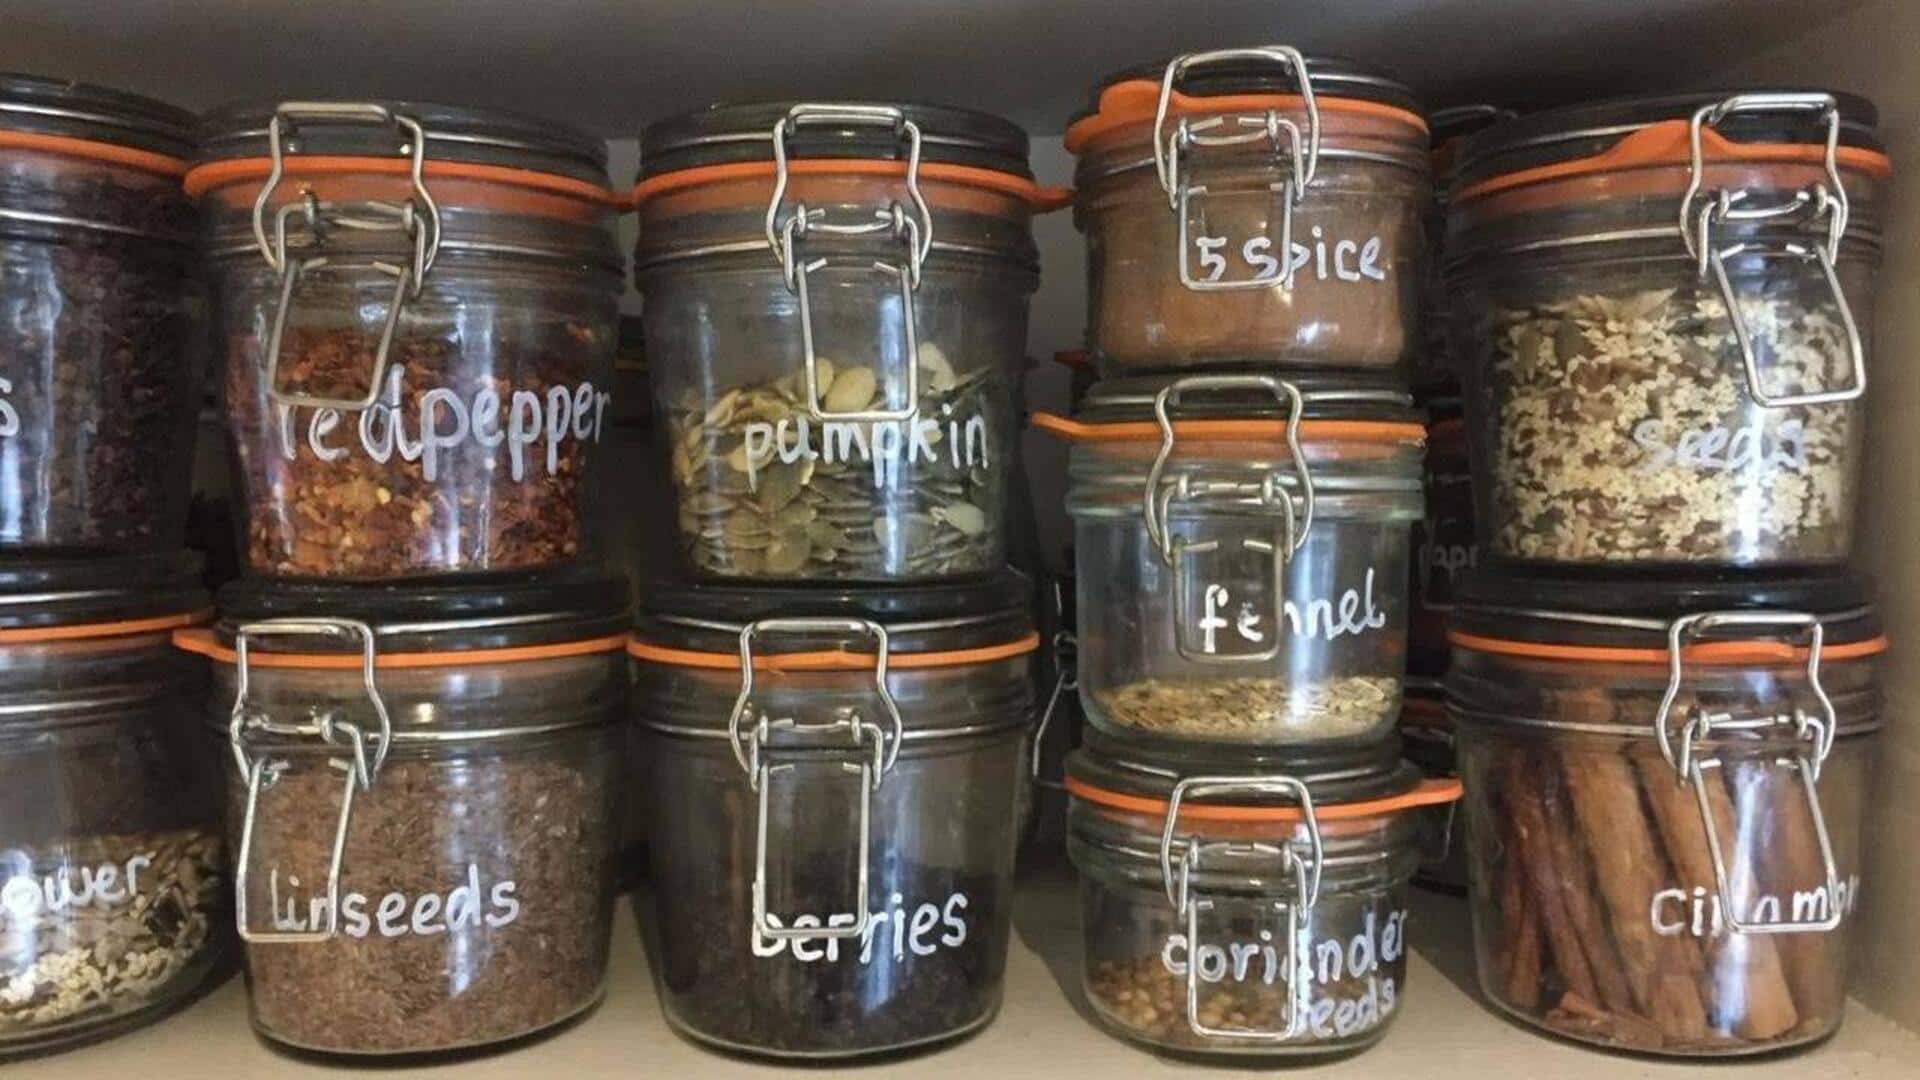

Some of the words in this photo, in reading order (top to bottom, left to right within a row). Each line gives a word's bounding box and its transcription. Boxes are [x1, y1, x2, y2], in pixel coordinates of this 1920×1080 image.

[1196, 236, 1227, 282] 5
[1243, 226, 1384, 289] spice
[744, 402, 988, 493] pumpkin
[1199, 567, 1386, 653] fennel
[270, 863, 520, 937] linseeds
[752, 881, 968, 963] berries
